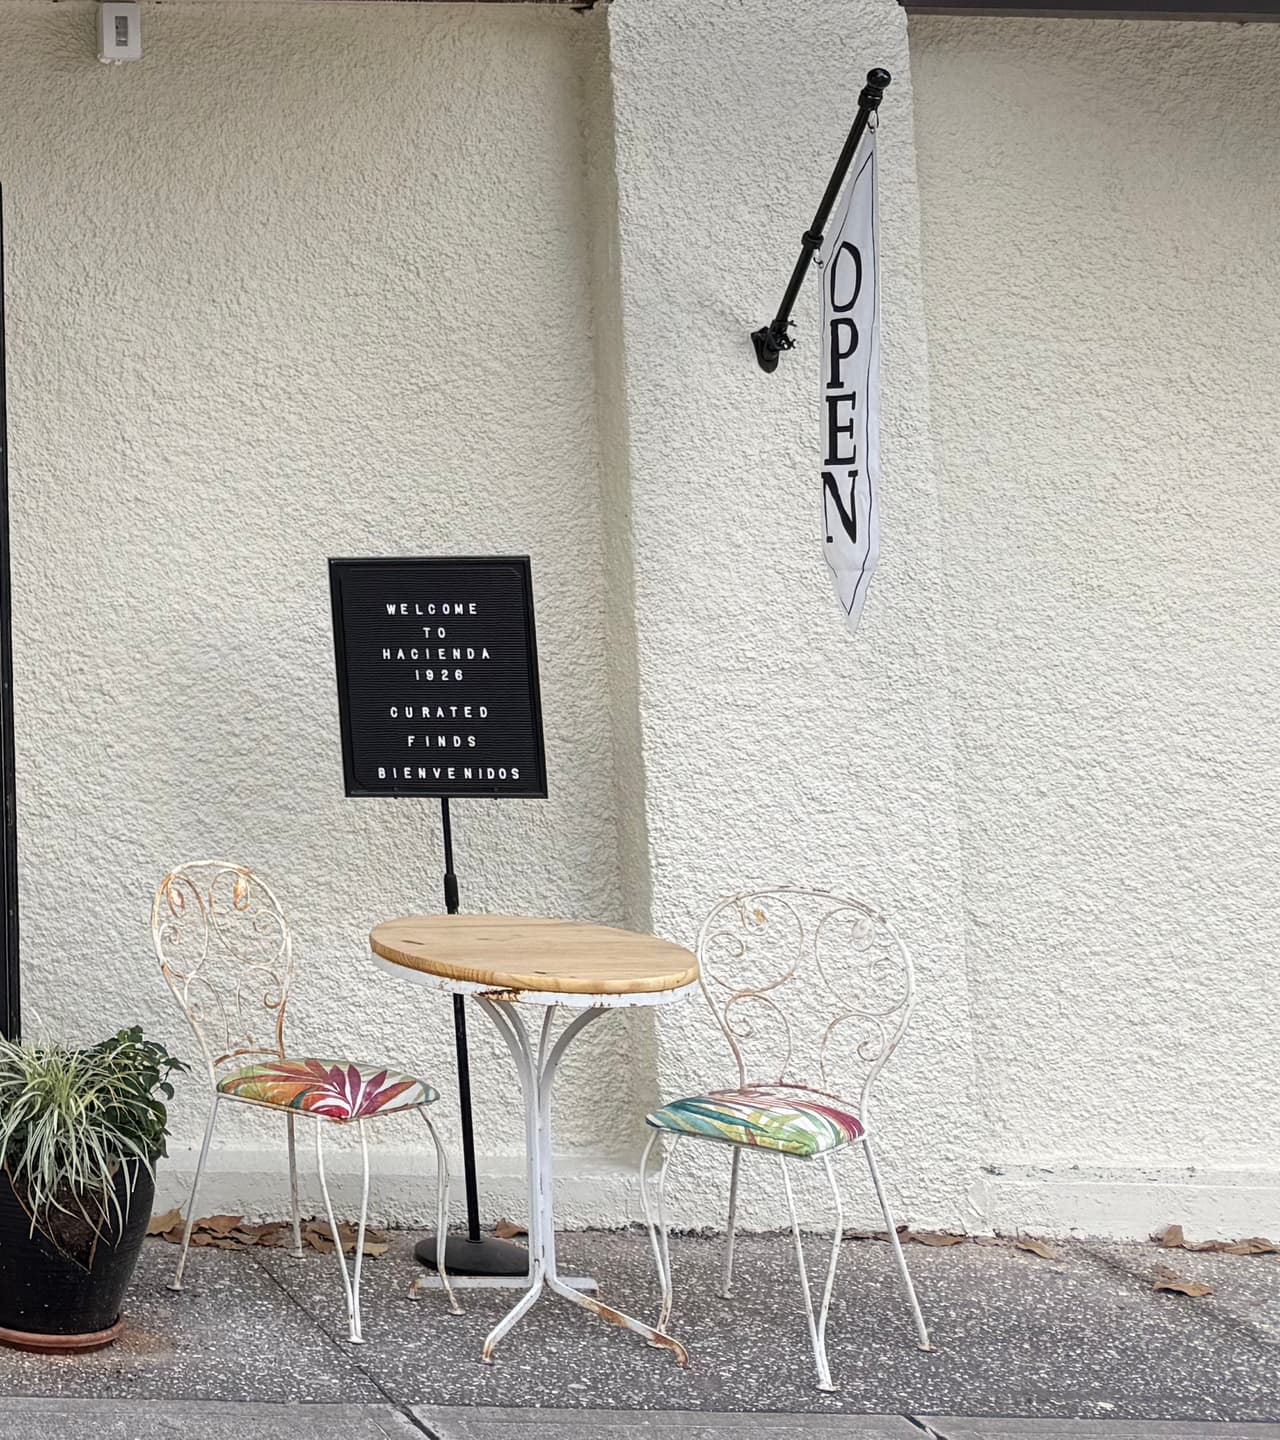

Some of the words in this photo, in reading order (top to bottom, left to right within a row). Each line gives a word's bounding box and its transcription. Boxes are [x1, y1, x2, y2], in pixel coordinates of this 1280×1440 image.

[821, 241, 862, 544] OPEN
[386, 602, 478, 616] WELCOME
[422, 626, 447, 639] TO
[382, 647, 491, 661] HACIENDA
[415, 669, 464, 681] 1926
[390, 706, 489, 719] CURATED
[407, 735, 477, 748] FINDS
[377, 766, 520, 780] BIENVENIDOS
